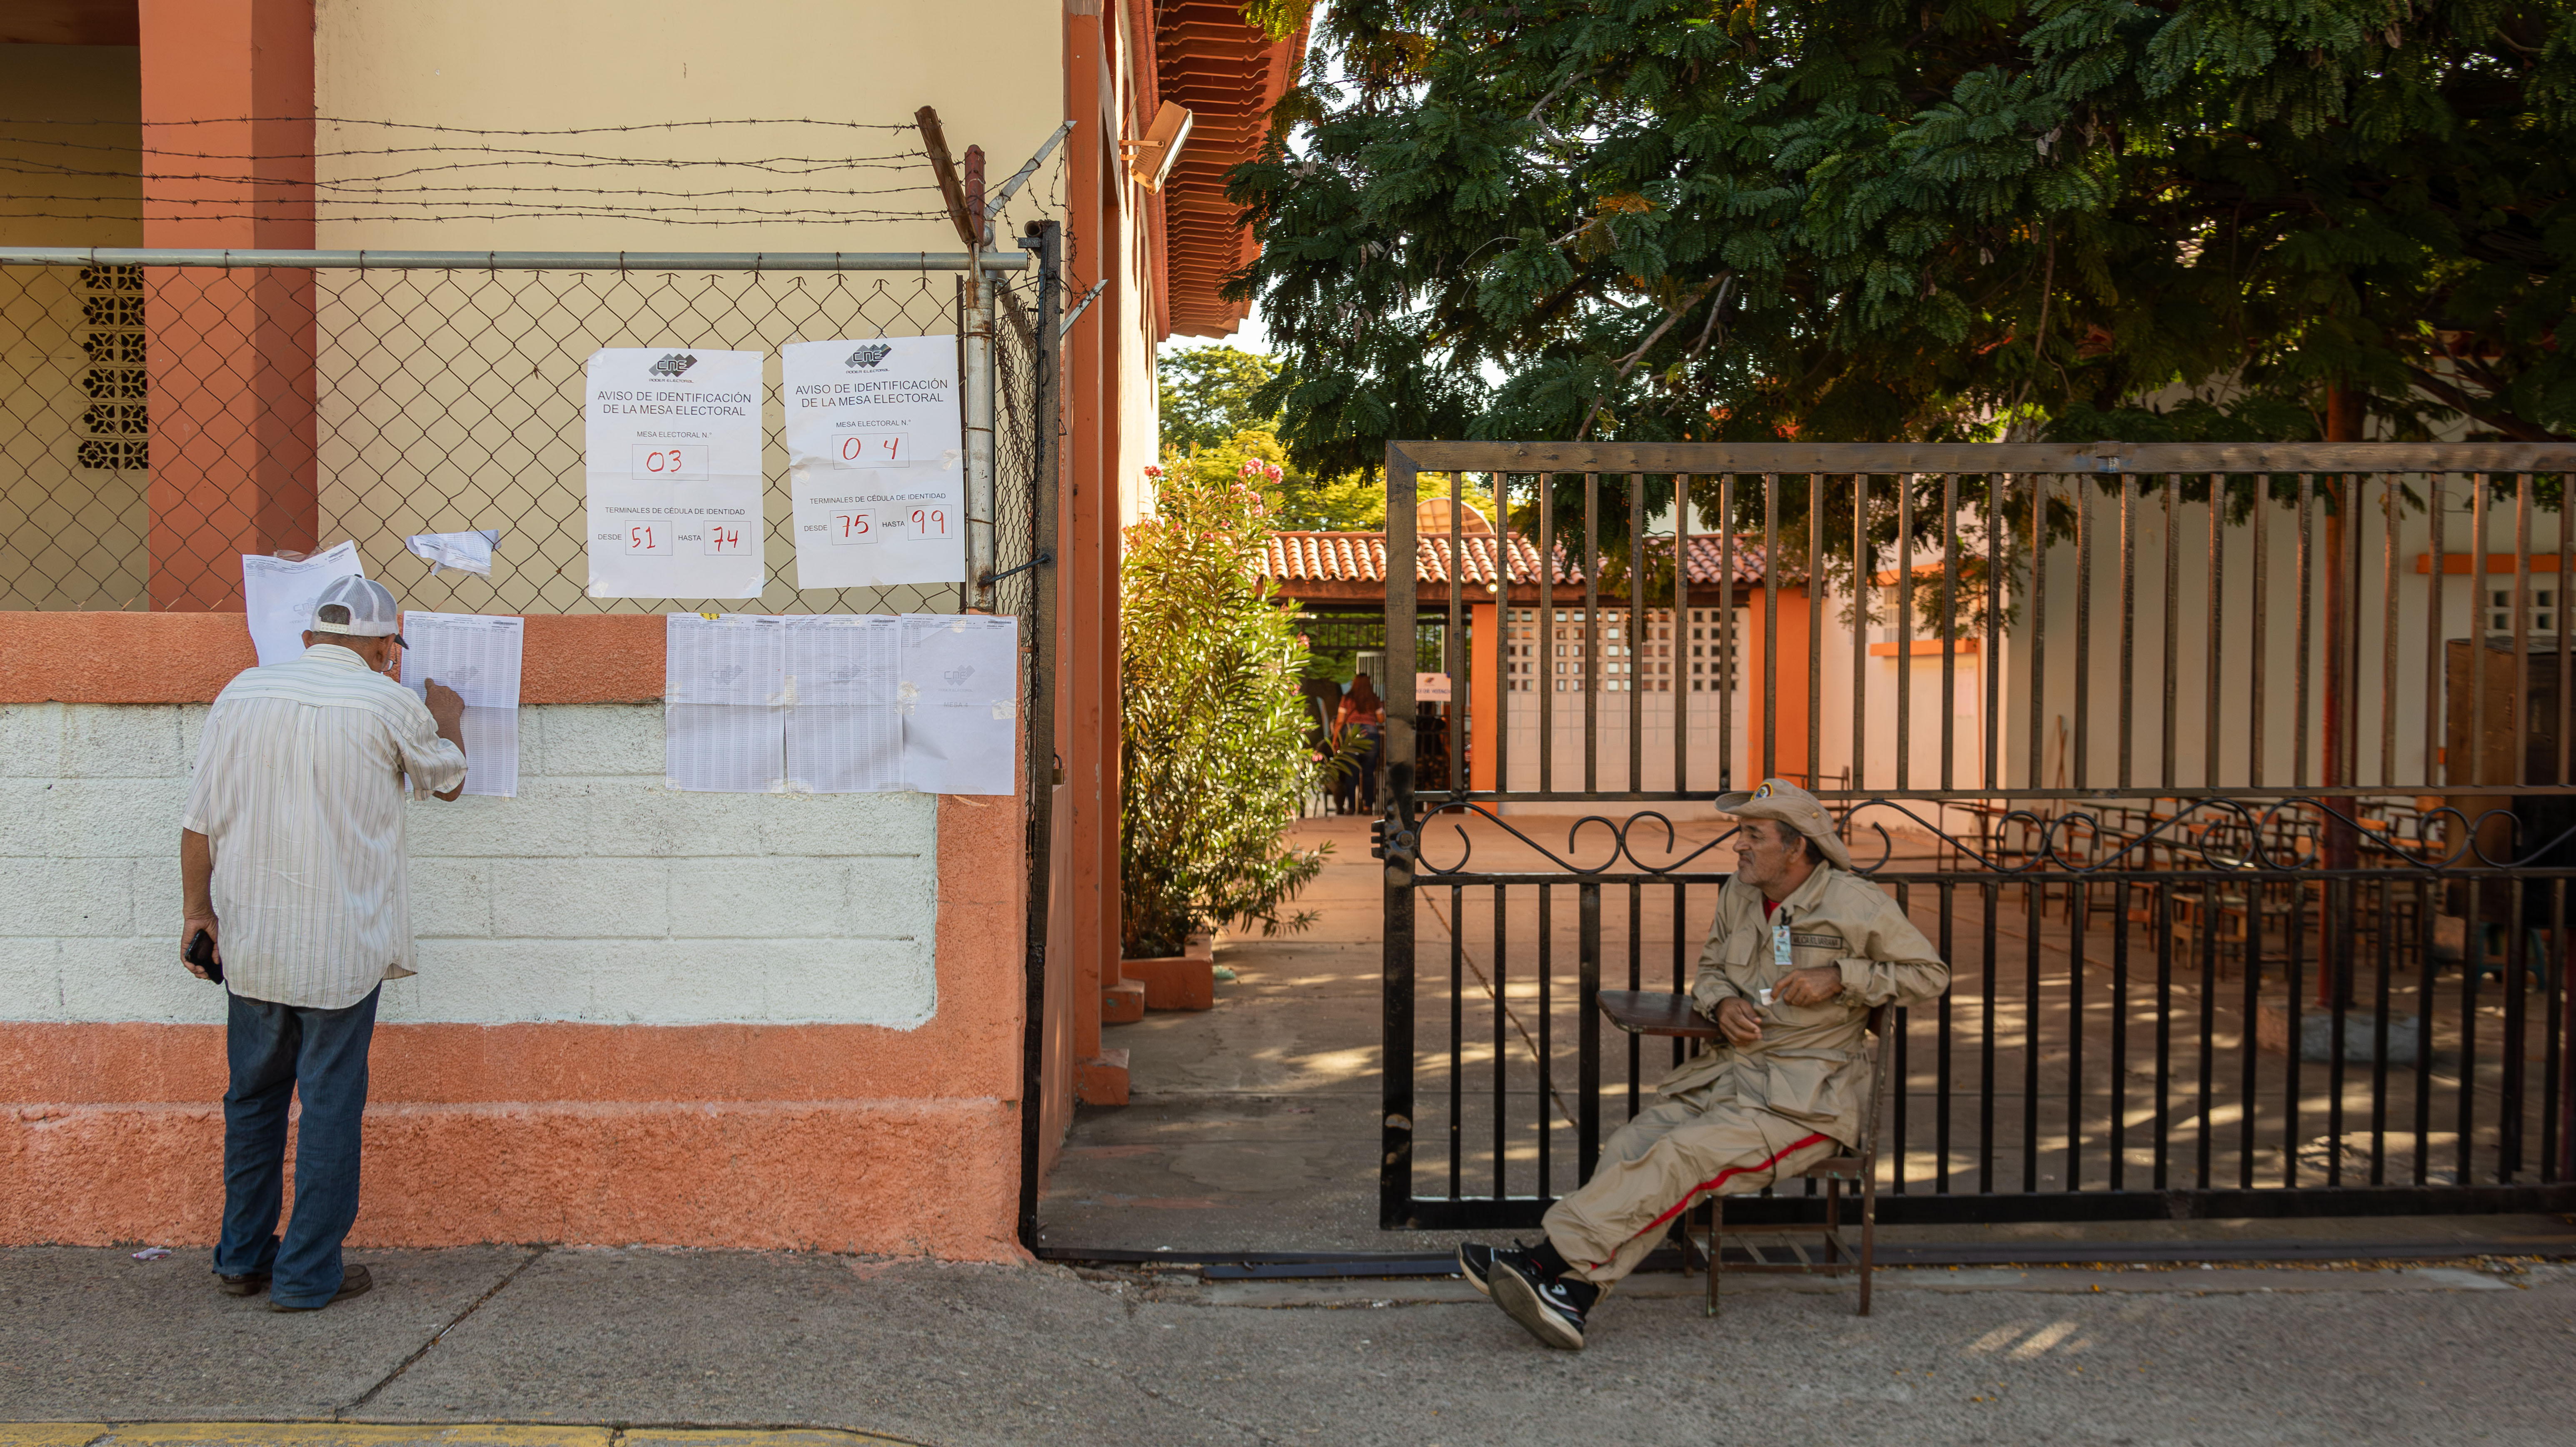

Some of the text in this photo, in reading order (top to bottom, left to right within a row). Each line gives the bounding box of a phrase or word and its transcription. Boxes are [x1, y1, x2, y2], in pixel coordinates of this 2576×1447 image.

[852, 350, 884, 362] CNE
[656, 360, 688, 372] CNE
[796, 378, 948, 395] AVISO DE IDENTIFICACIÓN
[598, 391, 751, 403] AVISO DE IDENTIFICACIÓN
[802, 393, 944, 407] DE LA MESA ELECTORAL
[604, 404, 746, 416] DE LA MESA ELECTORAL
[646, 450, 681, 472] 03
[836, 514, 869, 537] 75
[912, 510, 944, 534] 99
[632, 526, 656, 549] 51
[711, 526, 738, 552] 74
